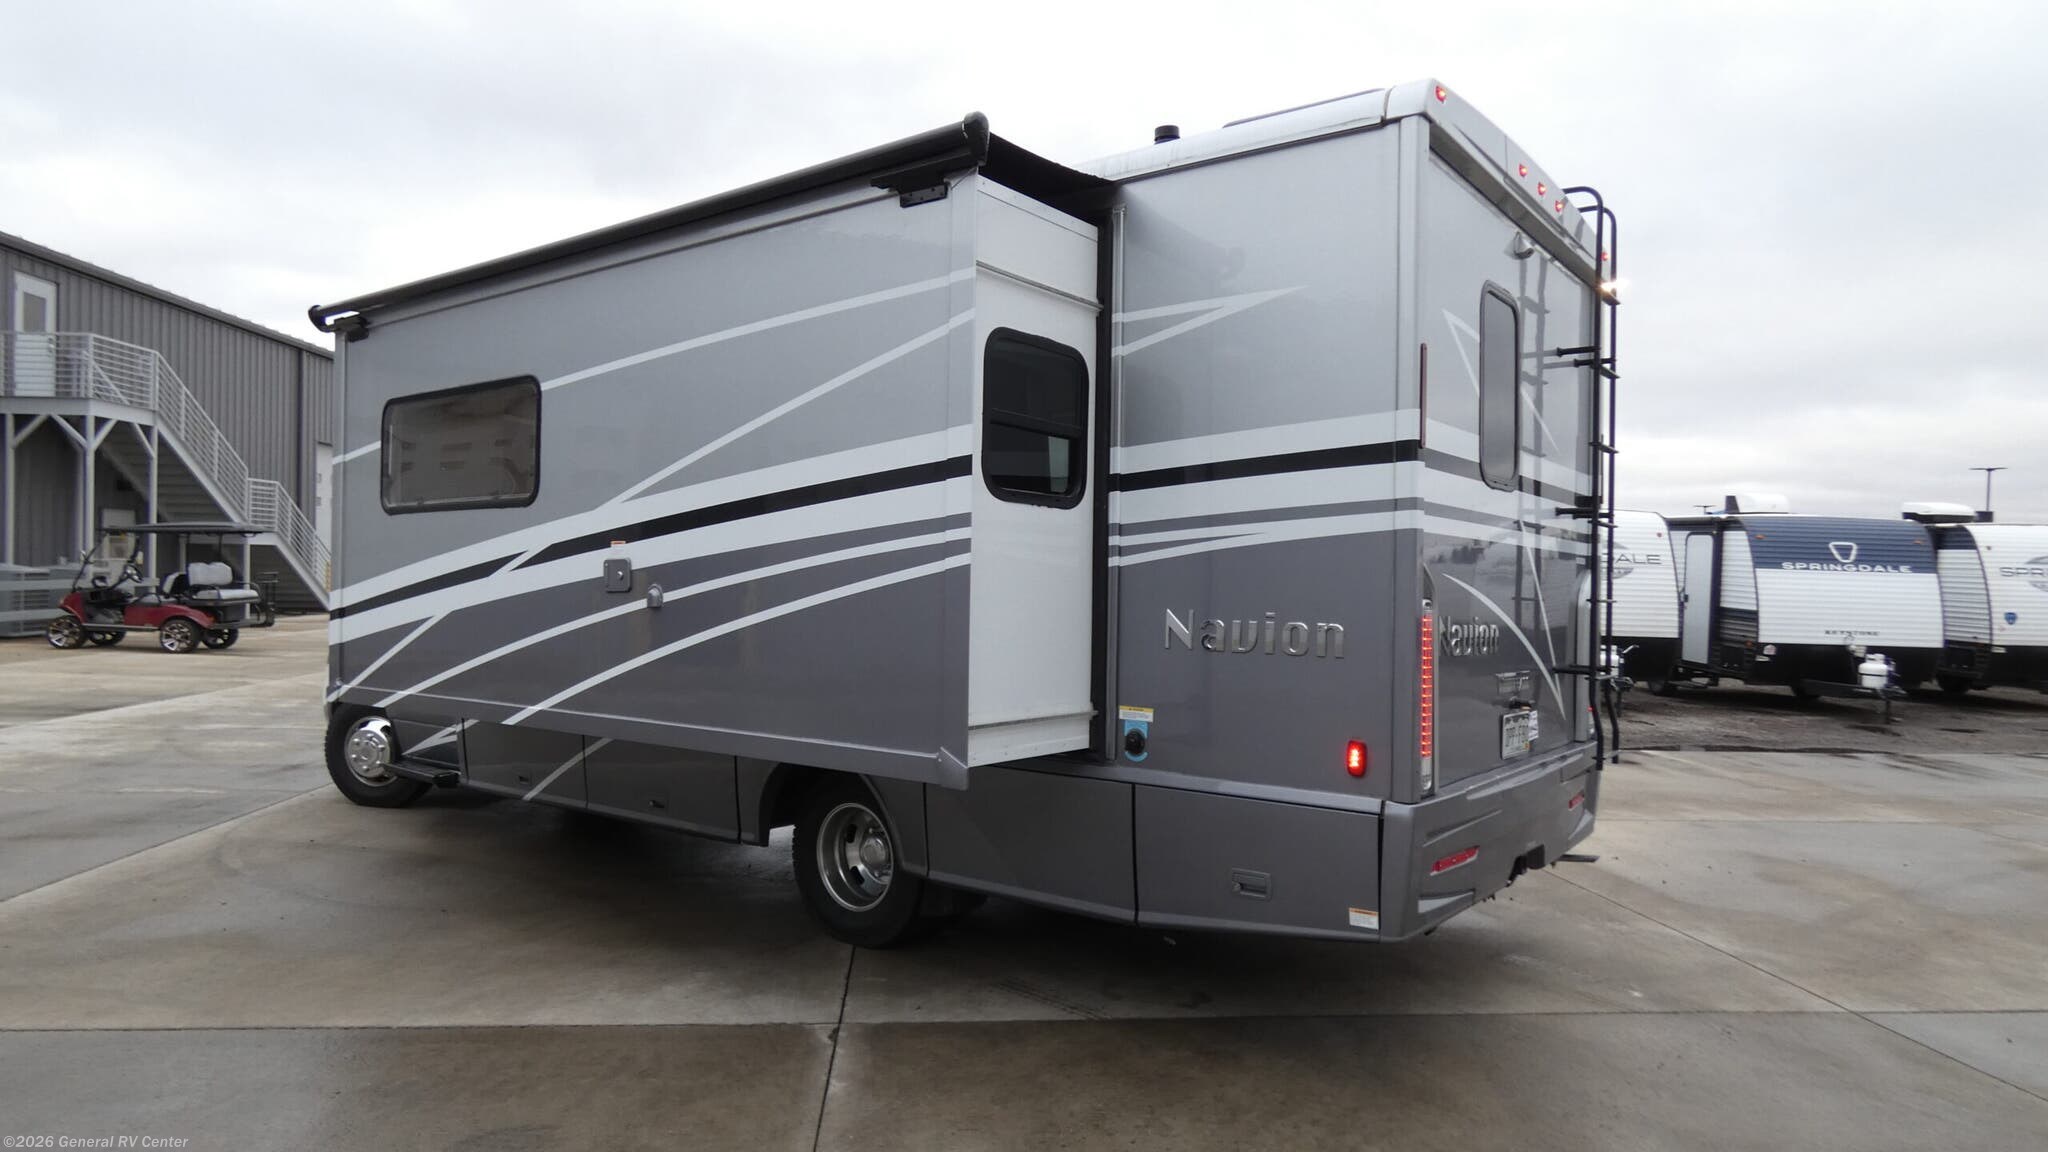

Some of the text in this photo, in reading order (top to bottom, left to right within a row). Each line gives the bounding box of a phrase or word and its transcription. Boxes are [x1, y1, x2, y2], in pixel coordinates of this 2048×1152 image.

[1781, 561, 1913, 574] SPRINGDALE
[1165, 608, 1344, 659] Navion
[1438, 615, 1499, 656] Navion
